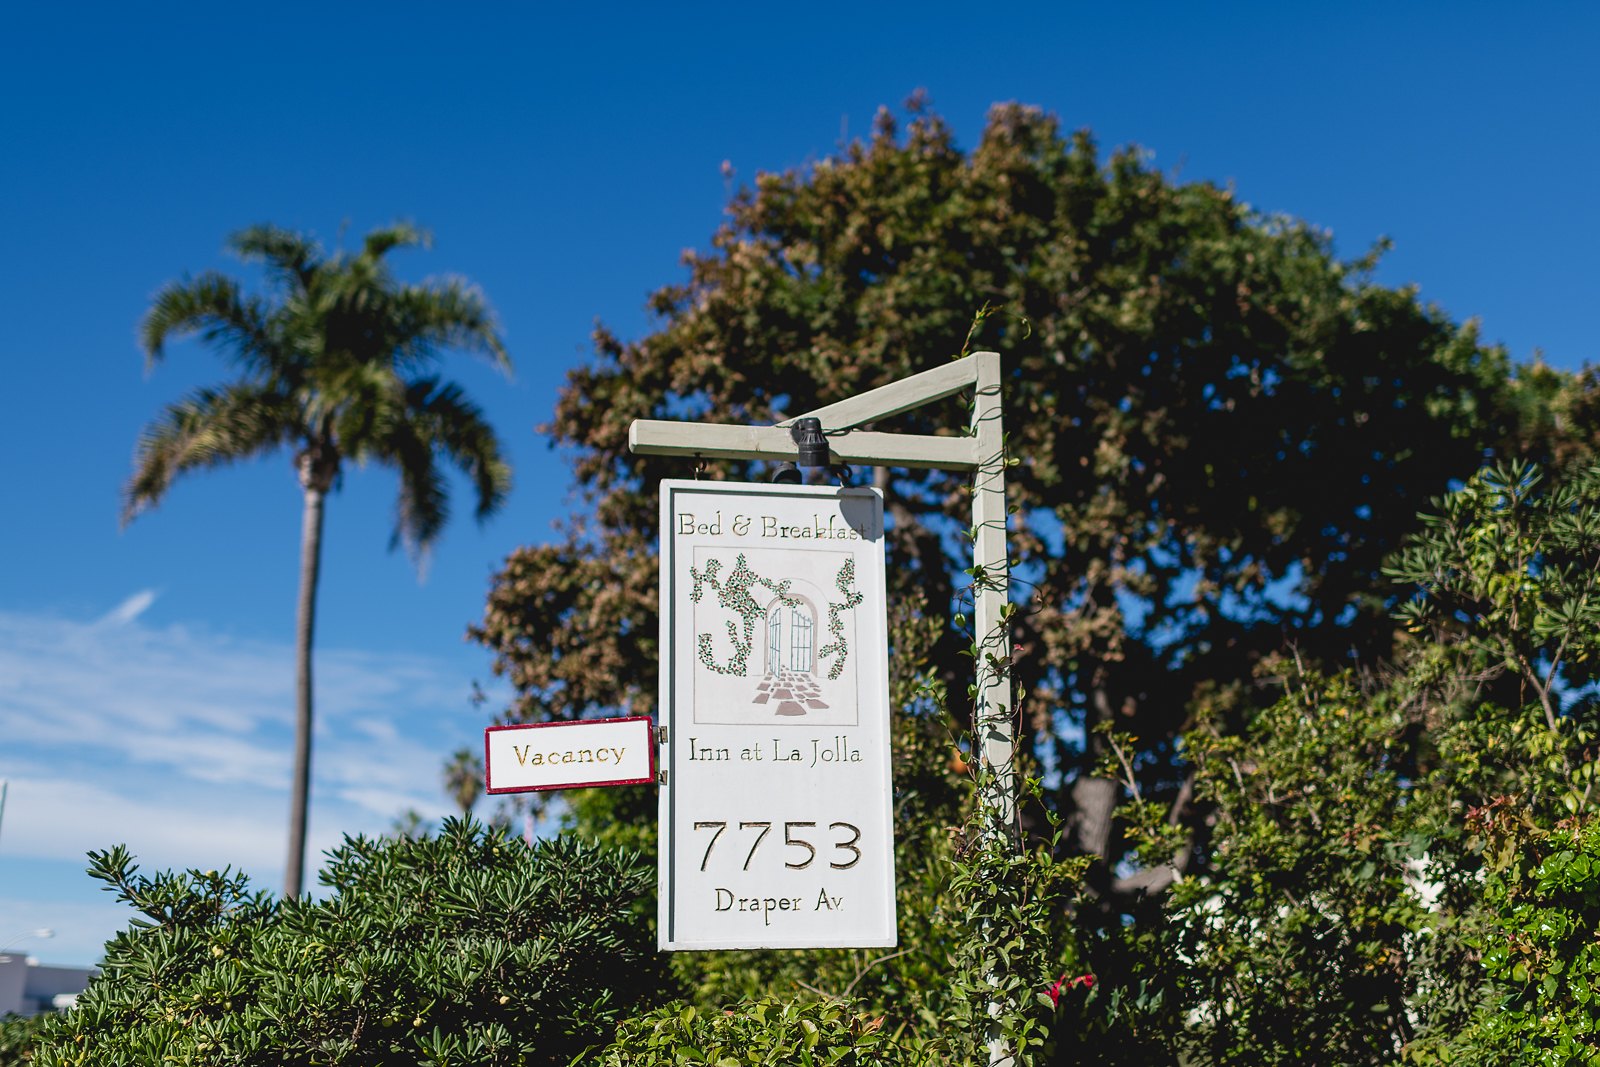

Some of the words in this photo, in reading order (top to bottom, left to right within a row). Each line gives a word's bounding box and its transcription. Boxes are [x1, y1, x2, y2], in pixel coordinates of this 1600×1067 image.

[678, 511, 723, 536] Bed
[732, 514, 752, 537] &
[761, 514, 866, 541] Breakfast
[513, 744, 626, 767] Vacancy
[689, 738, 731, 761] Inn
[740, 743, 763, 761] at
[772, 738, 803, 762] La
[810, 736, 863, 768] Jolla
[694, 821, 862, 872] 7753
[715, 888, 802, 926] Draper
